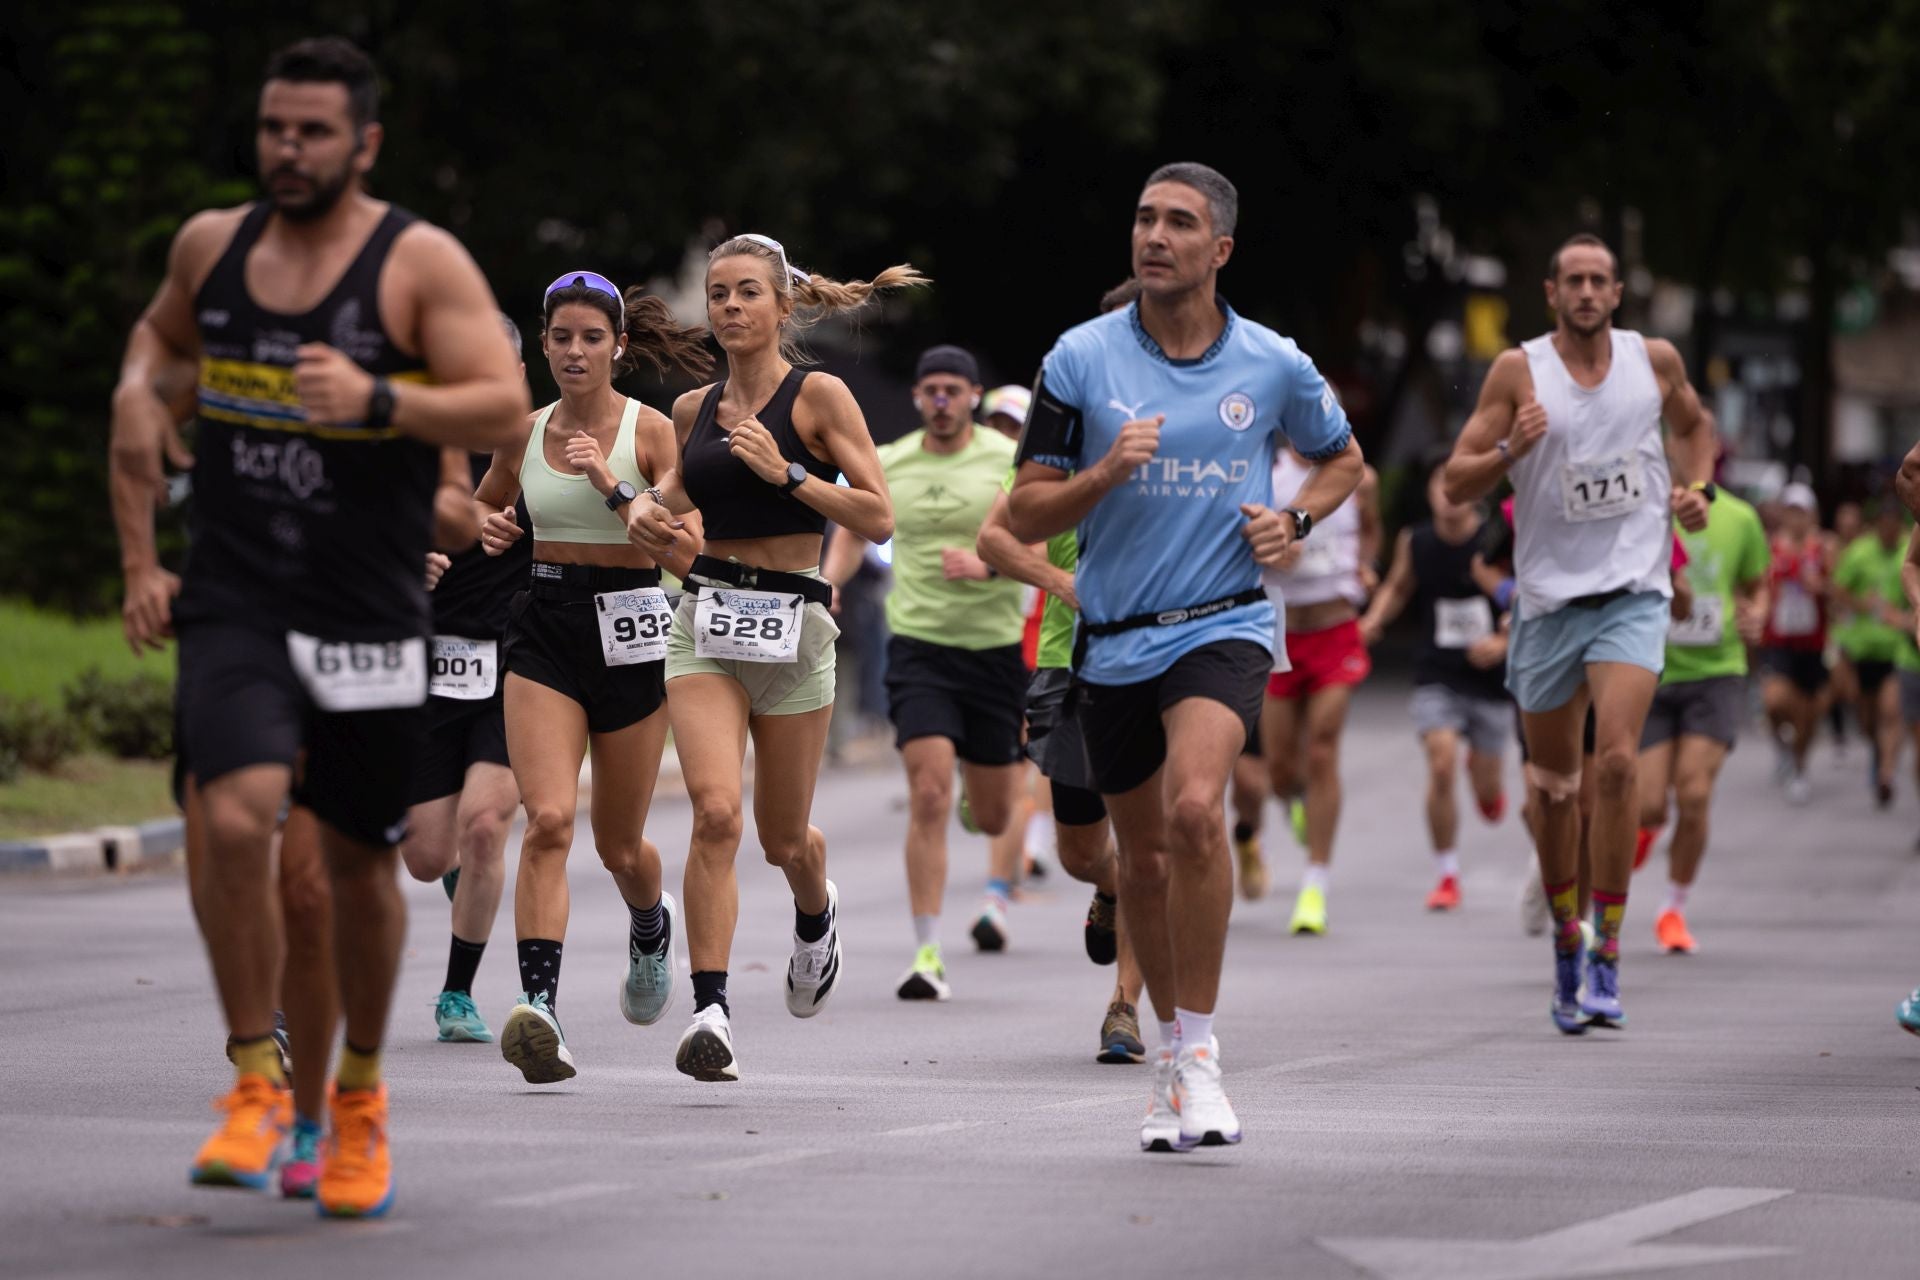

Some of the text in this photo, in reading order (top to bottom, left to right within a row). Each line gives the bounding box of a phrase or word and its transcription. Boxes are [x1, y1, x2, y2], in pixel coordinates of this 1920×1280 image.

[1130, 458, 1249, 483] TIHAD
[1574, 473, 1628, 502] 171
[613, 612, 673, 643] 932
[708, 612, 784, 641] 528
[434, 657, 483, 677] 001
